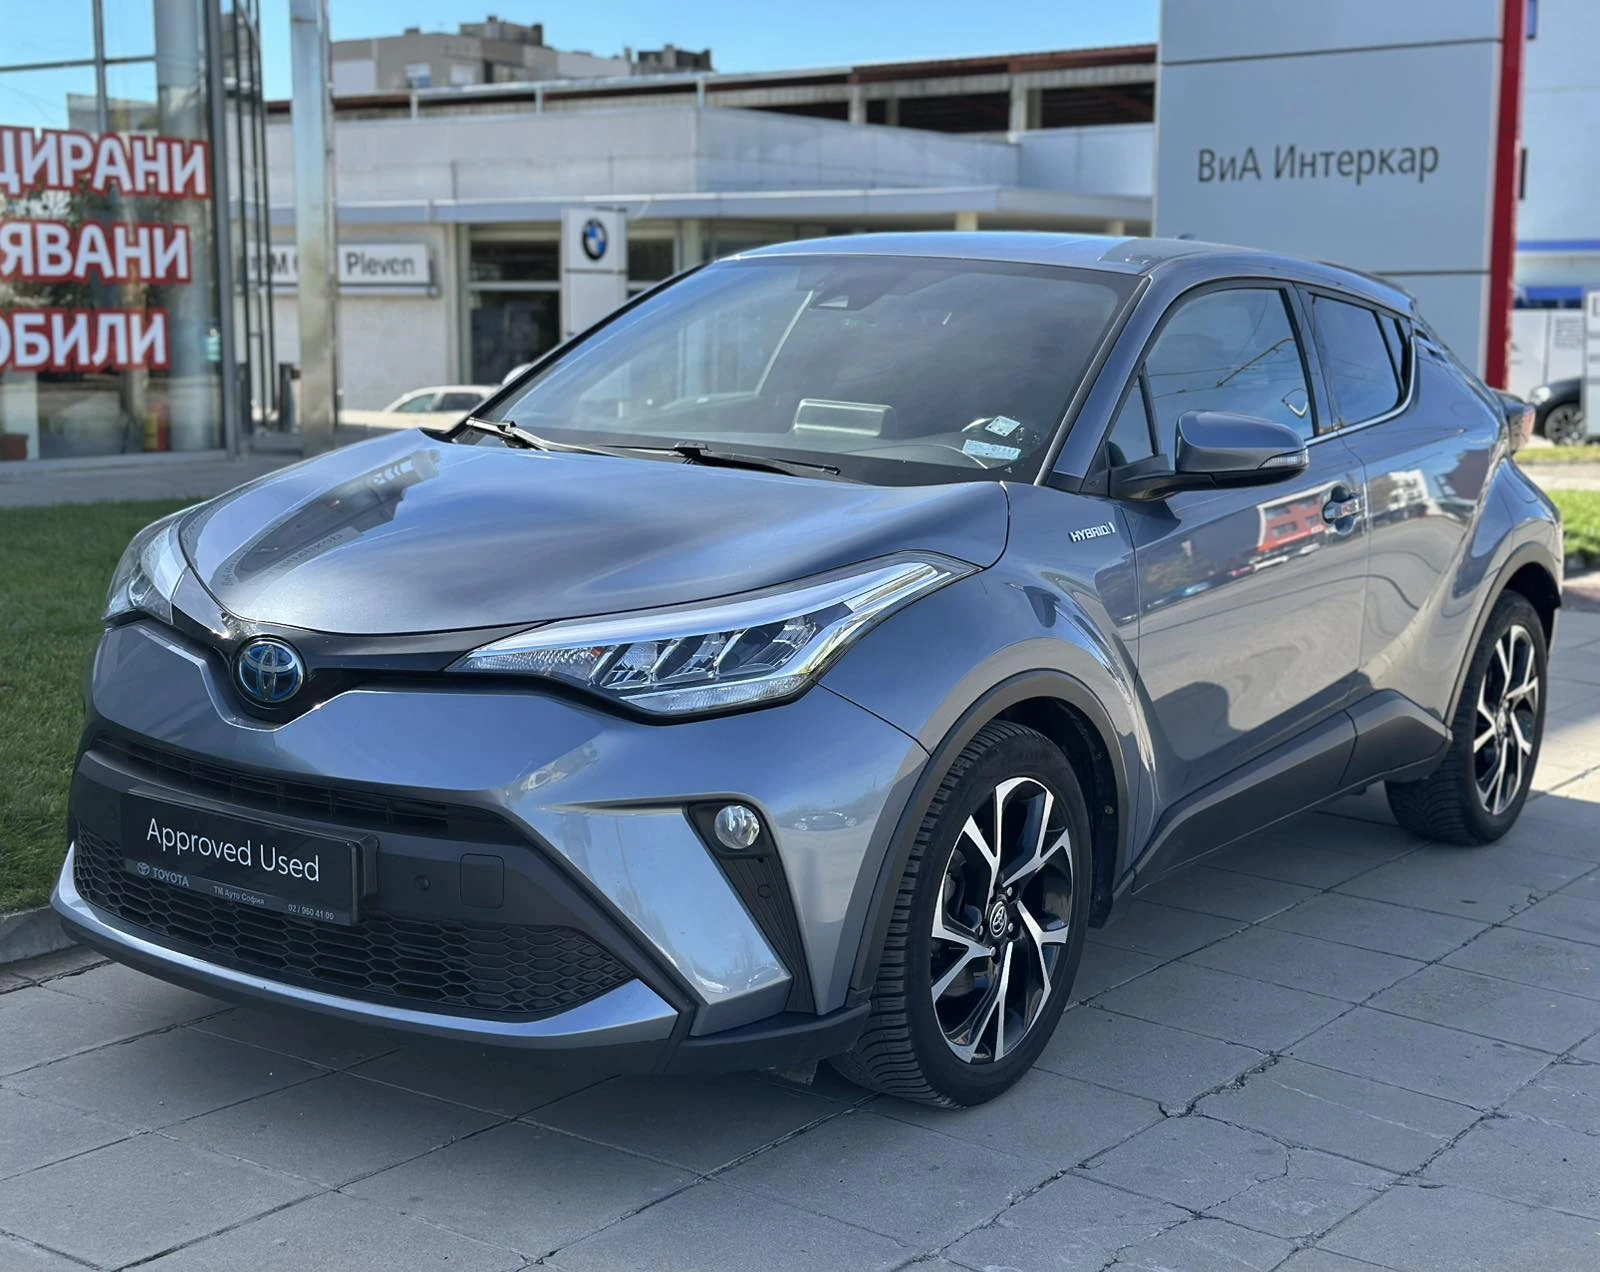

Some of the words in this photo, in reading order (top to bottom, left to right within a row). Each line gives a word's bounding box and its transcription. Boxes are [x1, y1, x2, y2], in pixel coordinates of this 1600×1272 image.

[1196, 147, 1262, 183] ВиА
[1273, 143, 1440, 186] Интеркар
[0, 221, 189, 280] ЯВАНИ
[346, 251, 416, 276] Pleven
[1069, 524, 1111, 542] HYBRID
[146, 817, 252, 867] Approved
[260, 844, 320, 882] Used
[152, 867, 190, 888] TOYOTA
[241, 892, 265, 906] София
[288, 903, 297, 913] 02
[315, 908, 324, 919] 41
